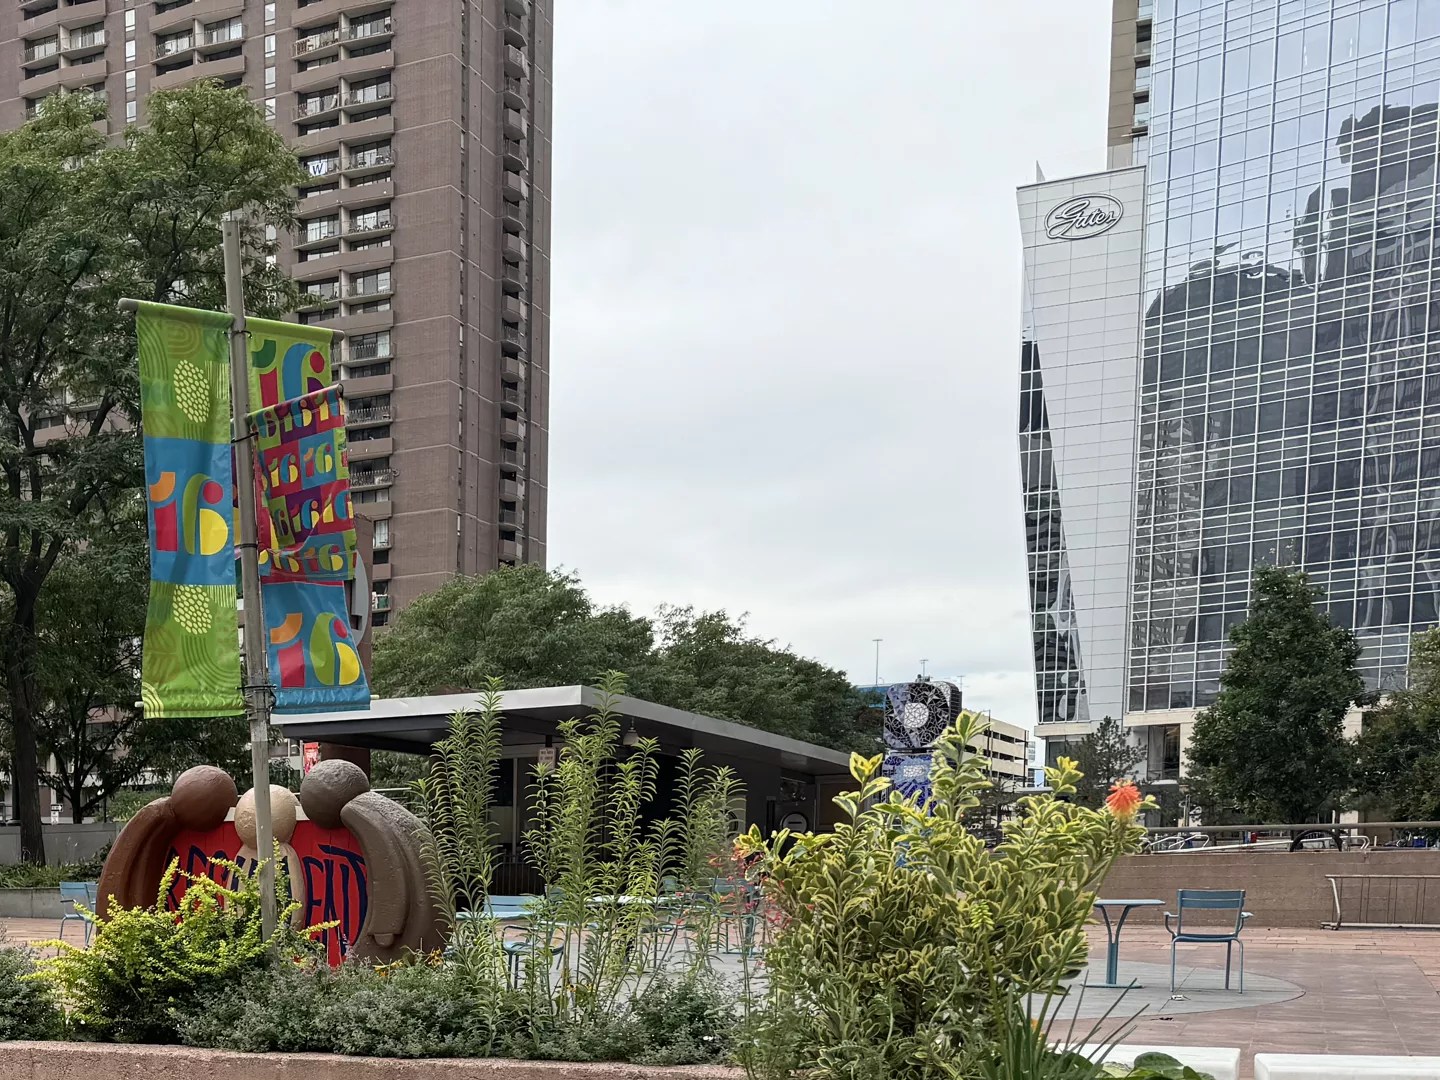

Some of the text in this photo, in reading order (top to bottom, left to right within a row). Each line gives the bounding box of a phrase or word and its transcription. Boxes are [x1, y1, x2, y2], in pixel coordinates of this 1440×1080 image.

[1046, 198, 1117, 239] Gates
[252, 339, 325, 410] 16
[268, 452, 298, 487] 16
[304, 442, 333, 479] 16
[149, 471, 228, 555] 16
[290, 498, 320, 534] 16
[304, 543, 344, 573] 16
[270, 612, 360, 688] 16
